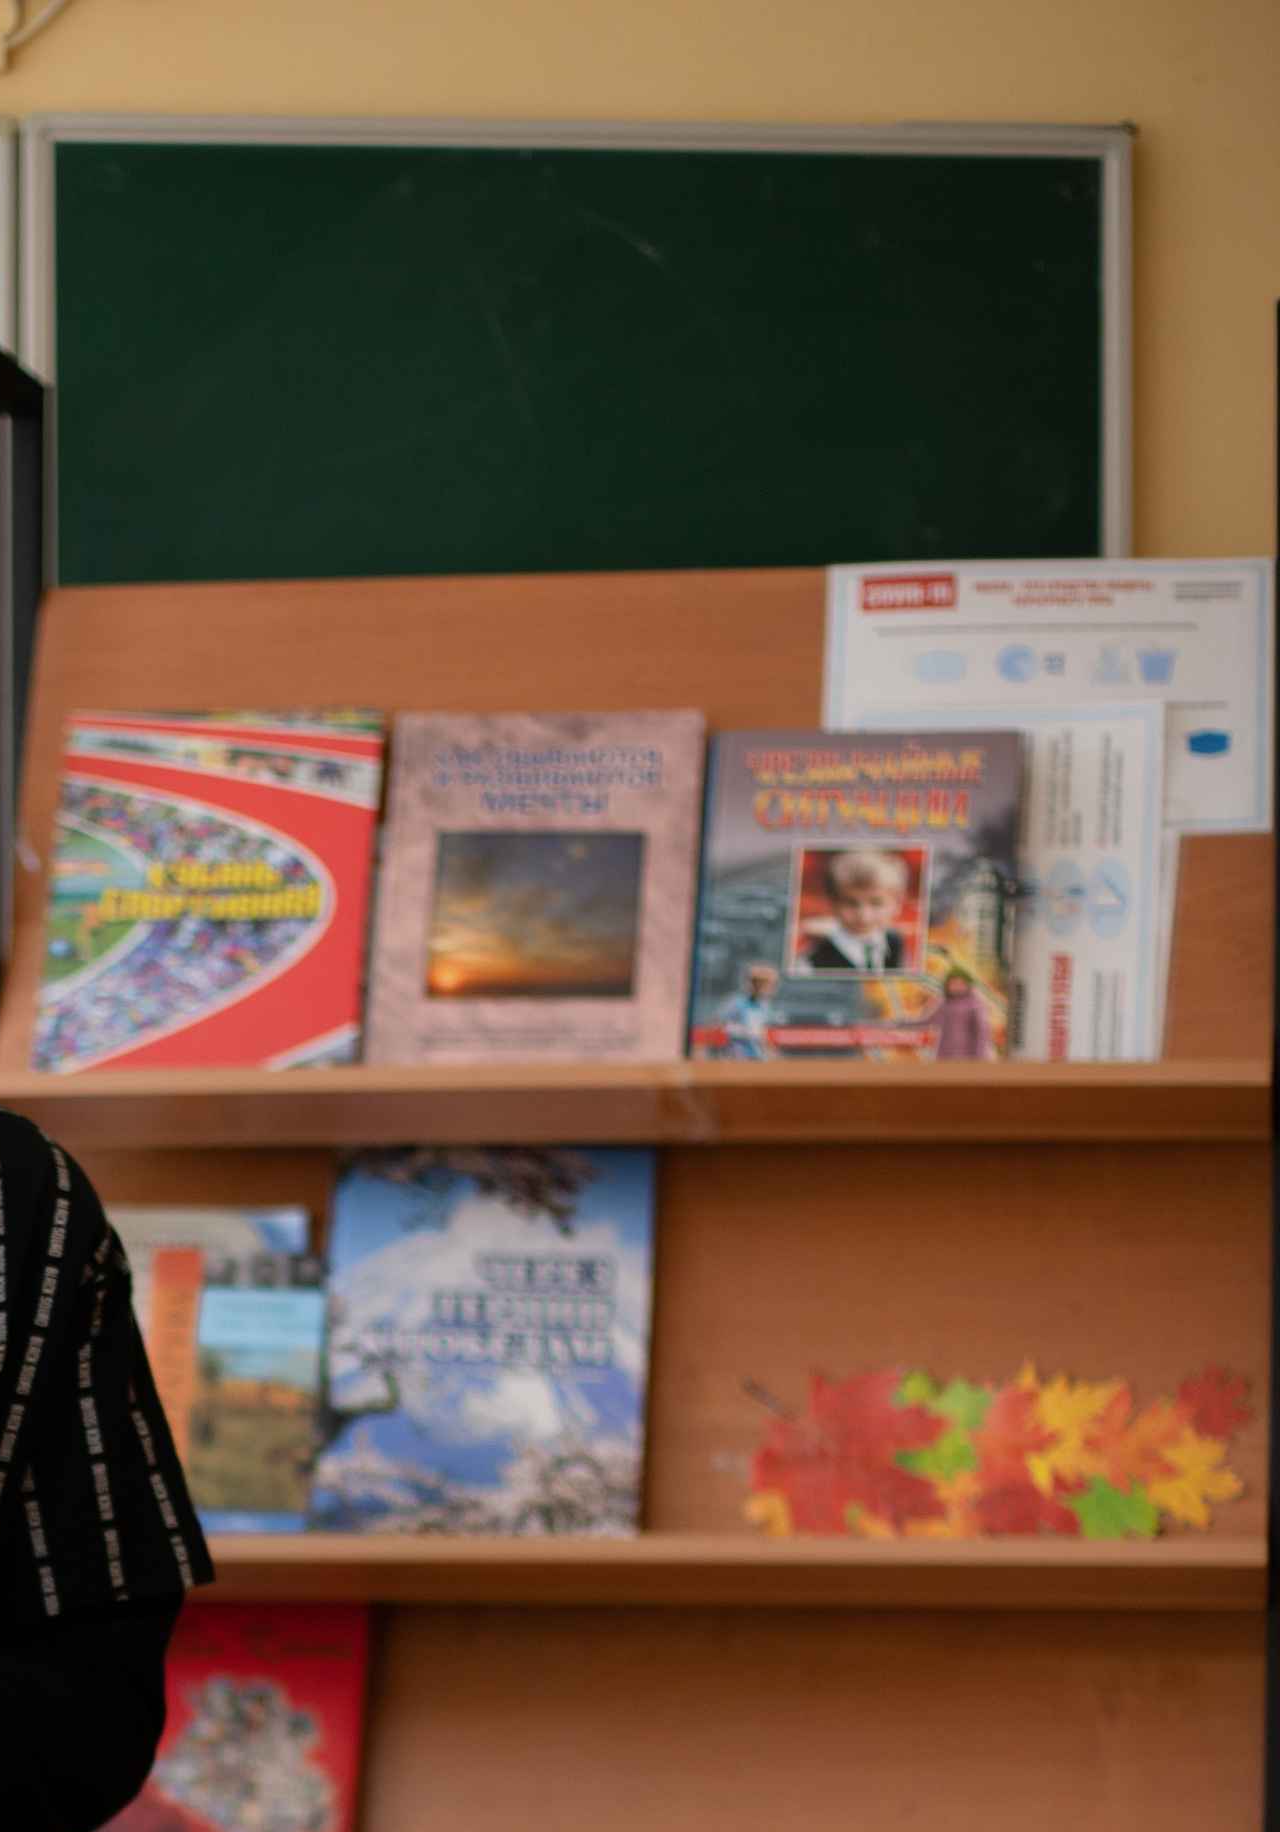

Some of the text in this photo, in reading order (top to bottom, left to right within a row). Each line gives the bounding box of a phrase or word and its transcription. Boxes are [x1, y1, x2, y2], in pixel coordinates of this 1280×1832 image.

[754, 788, 968, 835] СИТУАЦИИ
[54, 1198, 69, 1226] BLACK
[48, 1226, 65, 1257] SQUAD
[34, 1266, 58, 1326] BLACK SQUAD
